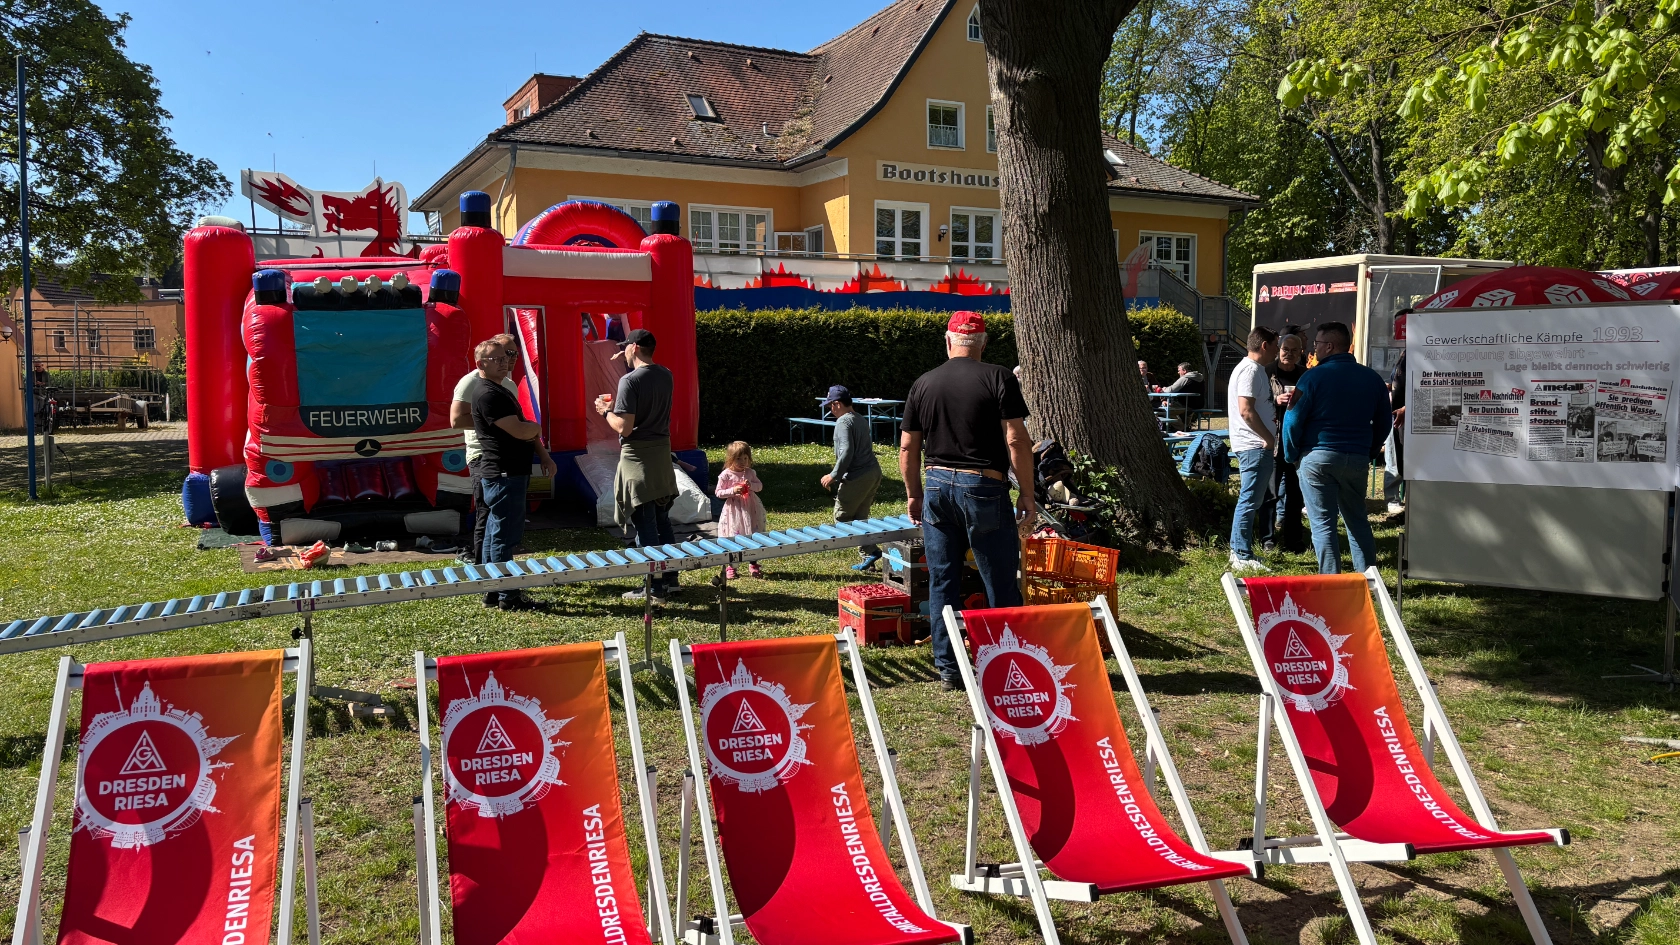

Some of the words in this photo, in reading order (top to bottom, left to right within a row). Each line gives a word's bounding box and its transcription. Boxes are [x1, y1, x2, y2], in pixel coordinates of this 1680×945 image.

[882, 164, 999, 188] Bootshaus
[1425, 333, 1533, 345] Gewerkschaftliche
[1536, 332, 1583, 344] Kämpfe
[1592, 326, 1644, 342] 1993
[1424, 349, 1505, 362] Abkopplung
[1508, 347, 1585, 361] abgewehrt
[1504, 362, 1527, 372] Lage
[1531, 362, 1562, 371] bleibt
[1565, 361, 1613, 371] dennoch
[1615, 360, 1670, 372] schwierig
[1433, 370, 1471, 378] Nervenkrieg
[1432, 378, 1485, 386] Stahl-Stufenplan
[1543, 383, 1584, 391] metall
[1463, 392, 1480, 400] Streik
[1530, 398, 1562, 406] Brand-
[1608, 394, 1619, 402] Sie
[1621, 396, 1653, 406] predigen
[1595, 400, 1628, 411] öffentlich
[309, 407, 422, 427] FEUERWEHR
[1471, 426, 1514, 437] Urabstimmung
[1274, 660, 1328, 673] DRESDEN
[1286, 673, 1322, 685] RIESA
[993, 691, 1050, 707] DRESDEN
[1006, 704, 1044, 718] RIESA
[718, 732, 783, 751] DRESDEN
[460, 752, 533, 772] DRESDEN
[732, 748, 774, 763] RIESA
[475, 769, 522, 785] RIESA
[99, 773, 187, 796] DRESDEN
[114, 793, 169, 811] RIESA
[582, 803, 628, 945] LDRESDENRIESA
